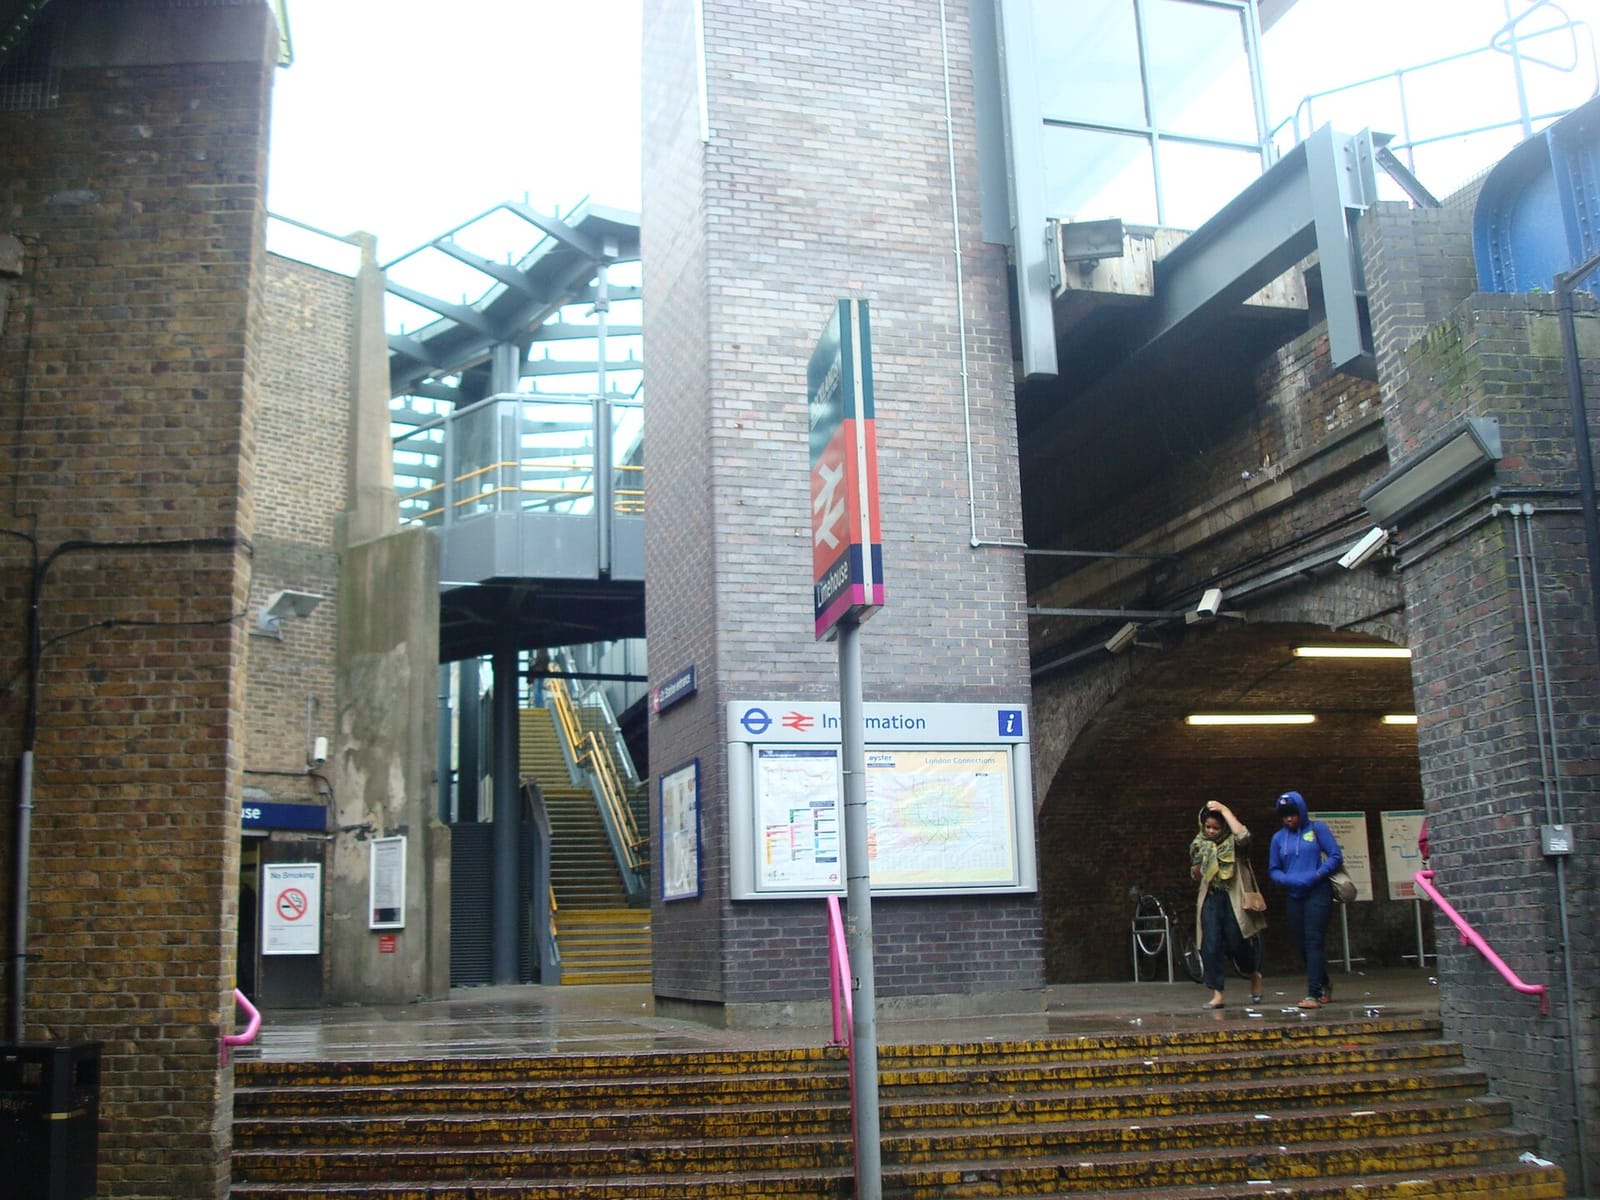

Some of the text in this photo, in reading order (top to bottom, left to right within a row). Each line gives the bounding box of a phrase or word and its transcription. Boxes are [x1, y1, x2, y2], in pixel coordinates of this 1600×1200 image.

[817, 561, 848, 608] Limehouse
[822, 714, 926, 729] Inmation
[868, 754, 892, 763] oyster
[925, 757, 996, 765] London Connections
[282, 872, 315, 880] Smoking
